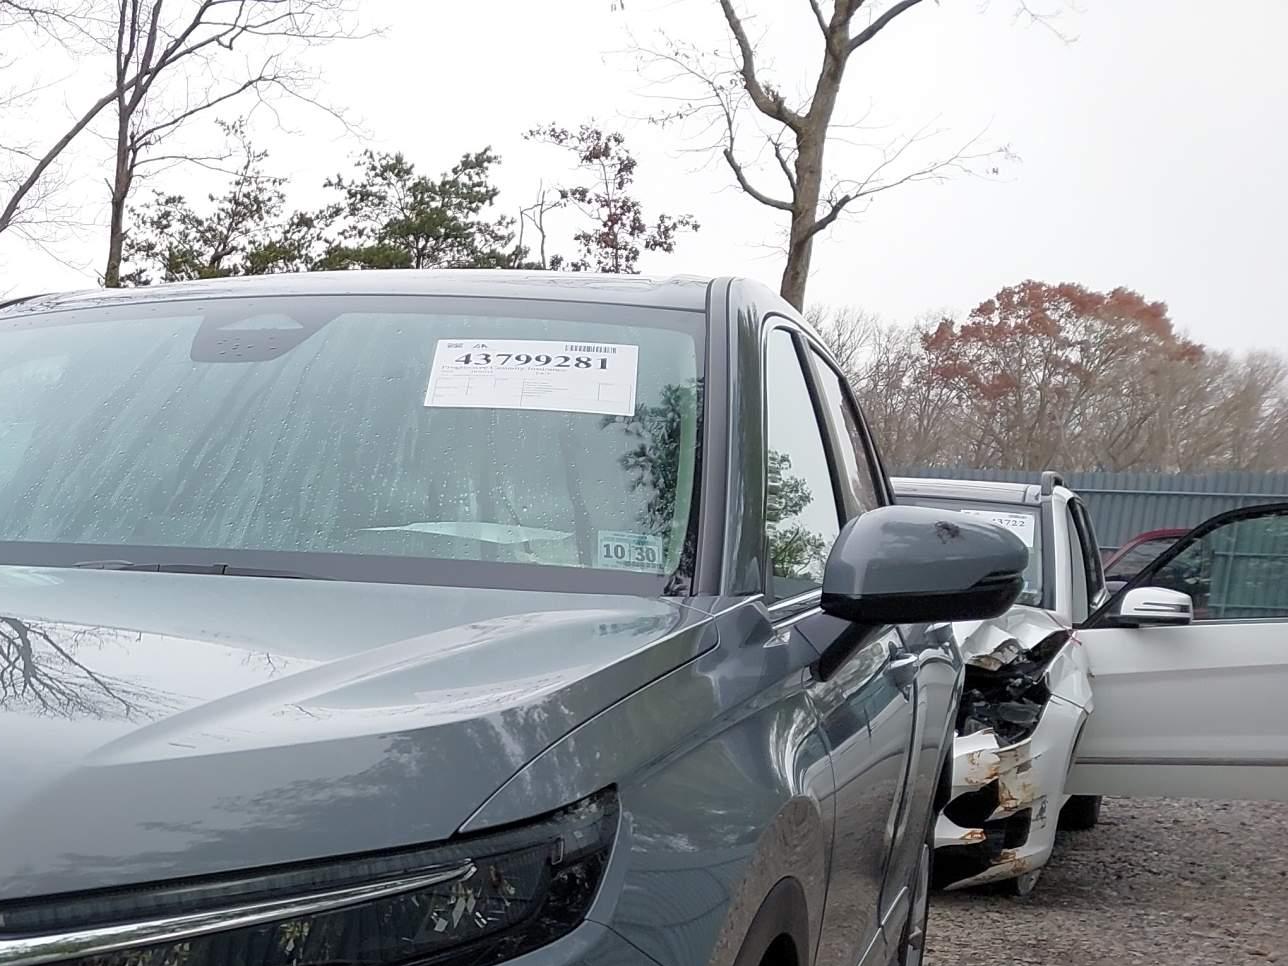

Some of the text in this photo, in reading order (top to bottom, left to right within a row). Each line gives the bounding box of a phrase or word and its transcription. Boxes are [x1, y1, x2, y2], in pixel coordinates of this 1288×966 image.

[454, 352, 608, 370] 43799281
[992, 518, 1025, 527] 3722
[603, 543, 657, 562] 10 30
